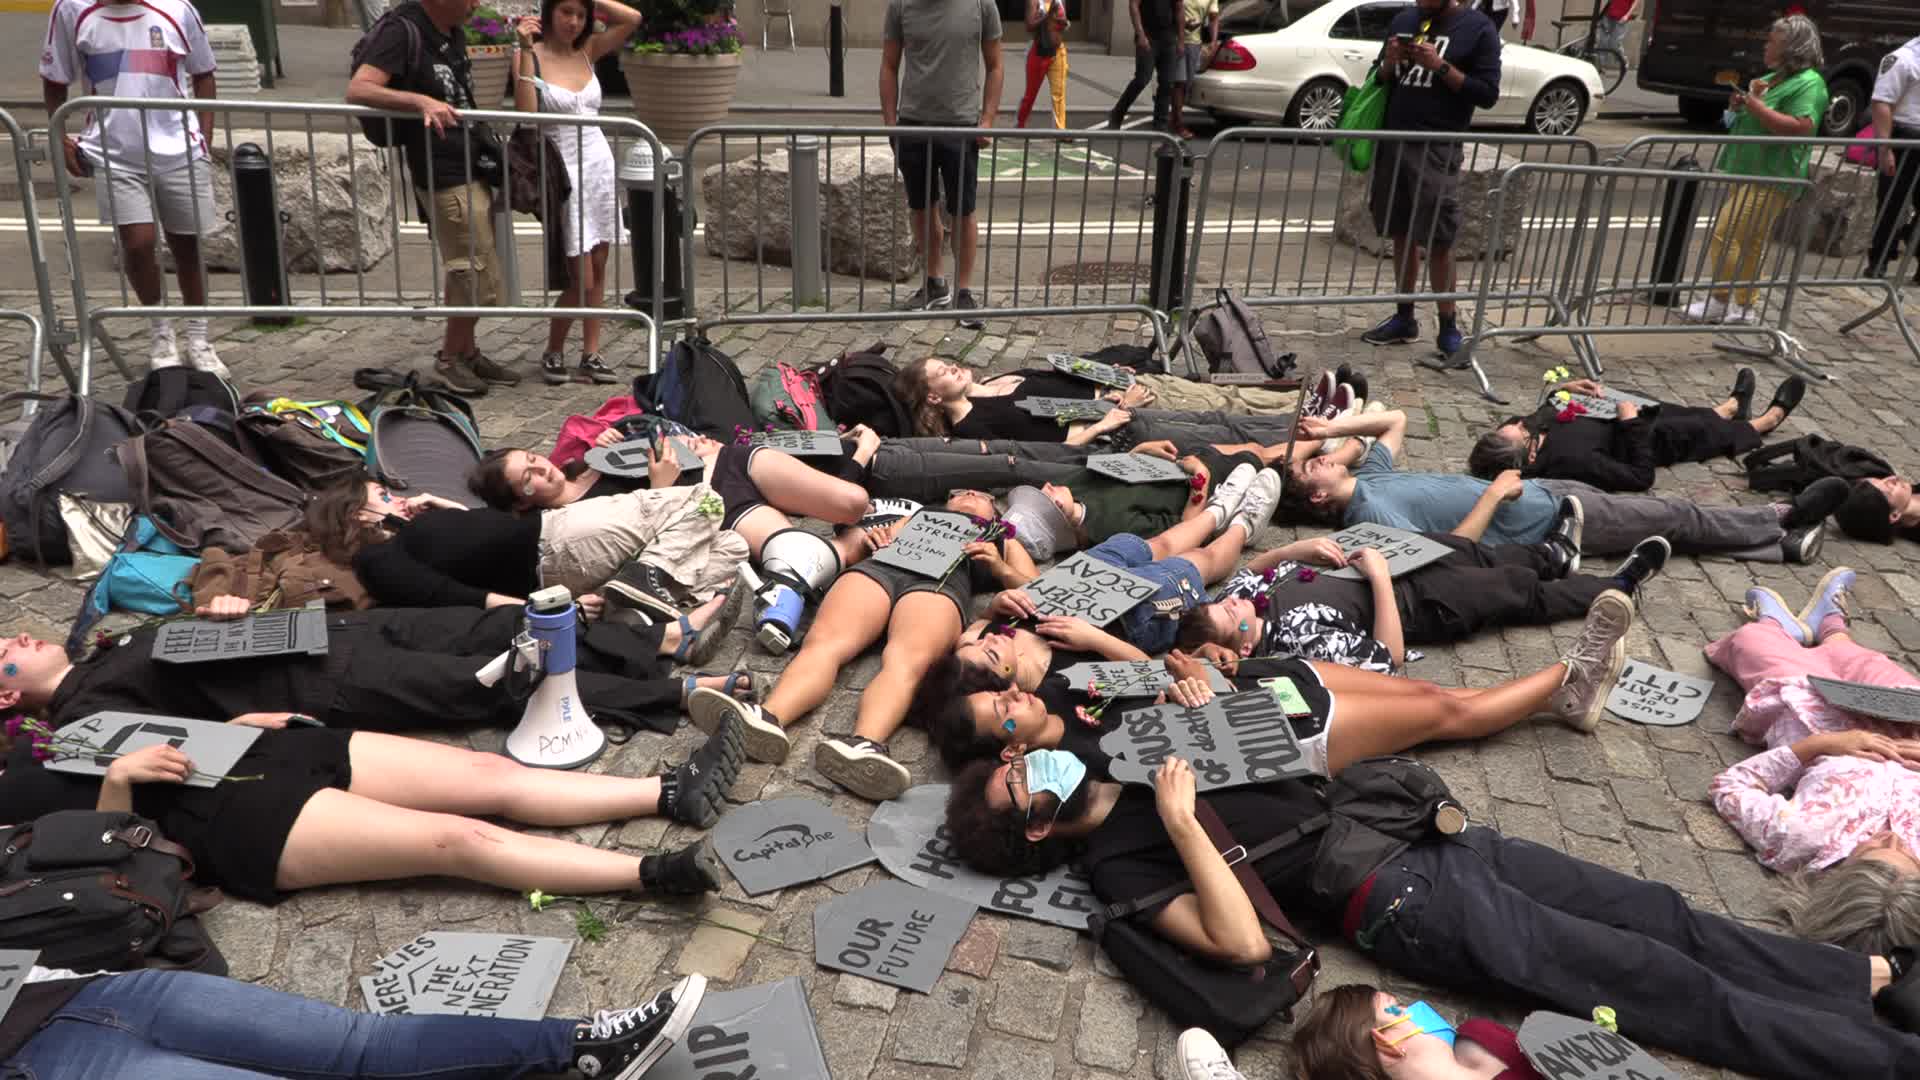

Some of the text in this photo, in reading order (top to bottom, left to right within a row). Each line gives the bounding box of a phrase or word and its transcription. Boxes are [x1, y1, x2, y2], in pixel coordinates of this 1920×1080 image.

[911, 523, 966, 543] STREET
[923, 513, 972, 537] WALL
[1346, 528, 1423, 556] PLANET
[893, 536, 947, 558] KILLING
[896, 546, 923, 561] US
[1057, 559, 1153, 600] DECAY
[1026, 578, 1118, 622] SYSTEM
[1620, 699, 1676, 719] CAUSE
[383, 936, 437, 970] LIES
[838, 917, 894, 969] OUR
[876, 909, 936, 979] FUTURE
[422, 964, 460, 994] THE
[442, 955, 489, 1008] NEXT
[463, 938, 537, 1017] NERATION
[1534, 1030, 1638, 1080] AMAZON
